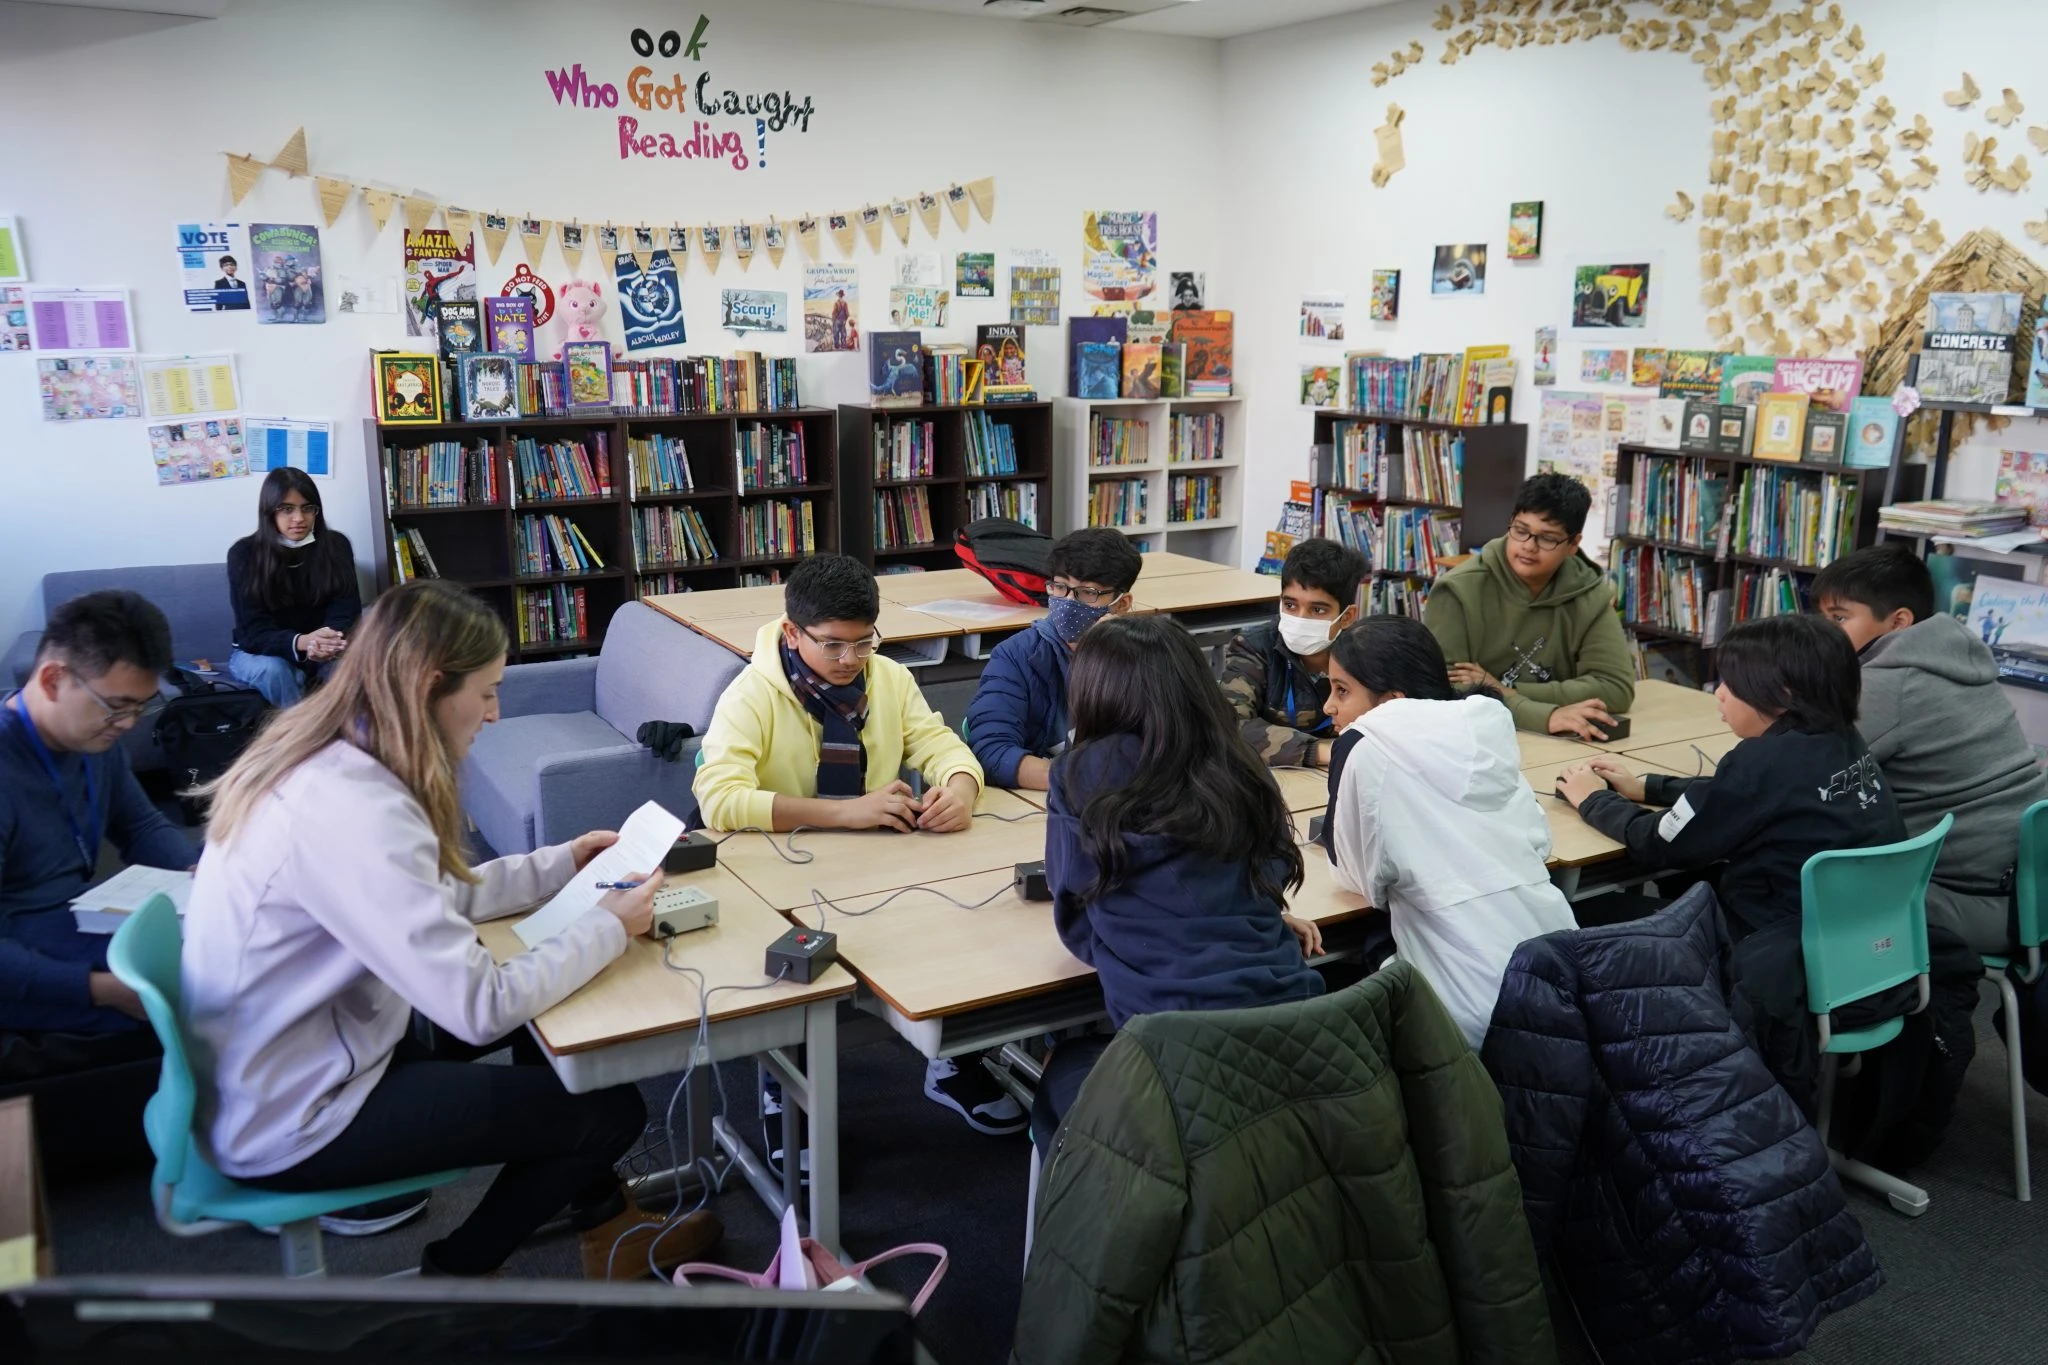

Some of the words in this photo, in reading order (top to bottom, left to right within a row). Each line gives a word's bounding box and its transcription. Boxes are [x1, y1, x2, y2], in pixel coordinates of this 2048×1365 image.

[544, 63, 619, 109] Who
[627, 65, 687, 113] Got
[694, 71, 815, 133] Caught
[181, 231, 229, 245] VOTE
[406, 234, 457, 249] AMAZIN
[413, 248, 457, 258] FANTASY
[505, 281, 515, 292] DO
[515, 275, 531, 284] NOT
[532, 277, 547, 290] FEED
[906, 294, 932, 307] Pick
[441, 306, 459, 318] DOG
[459, 306, 475, 316] MAN
[732, 301, 776, 320] Scary!
[908, 306, 929, 319] Me!
[494, 313, 528, 323] NATE
[654, 331, 680, 344] HUXLEY
[988, 327, 1017, 336] INDIA
[1930, 334, 2007, 350] CONCRETE
[1803, 368, 1856, 393] GUM
